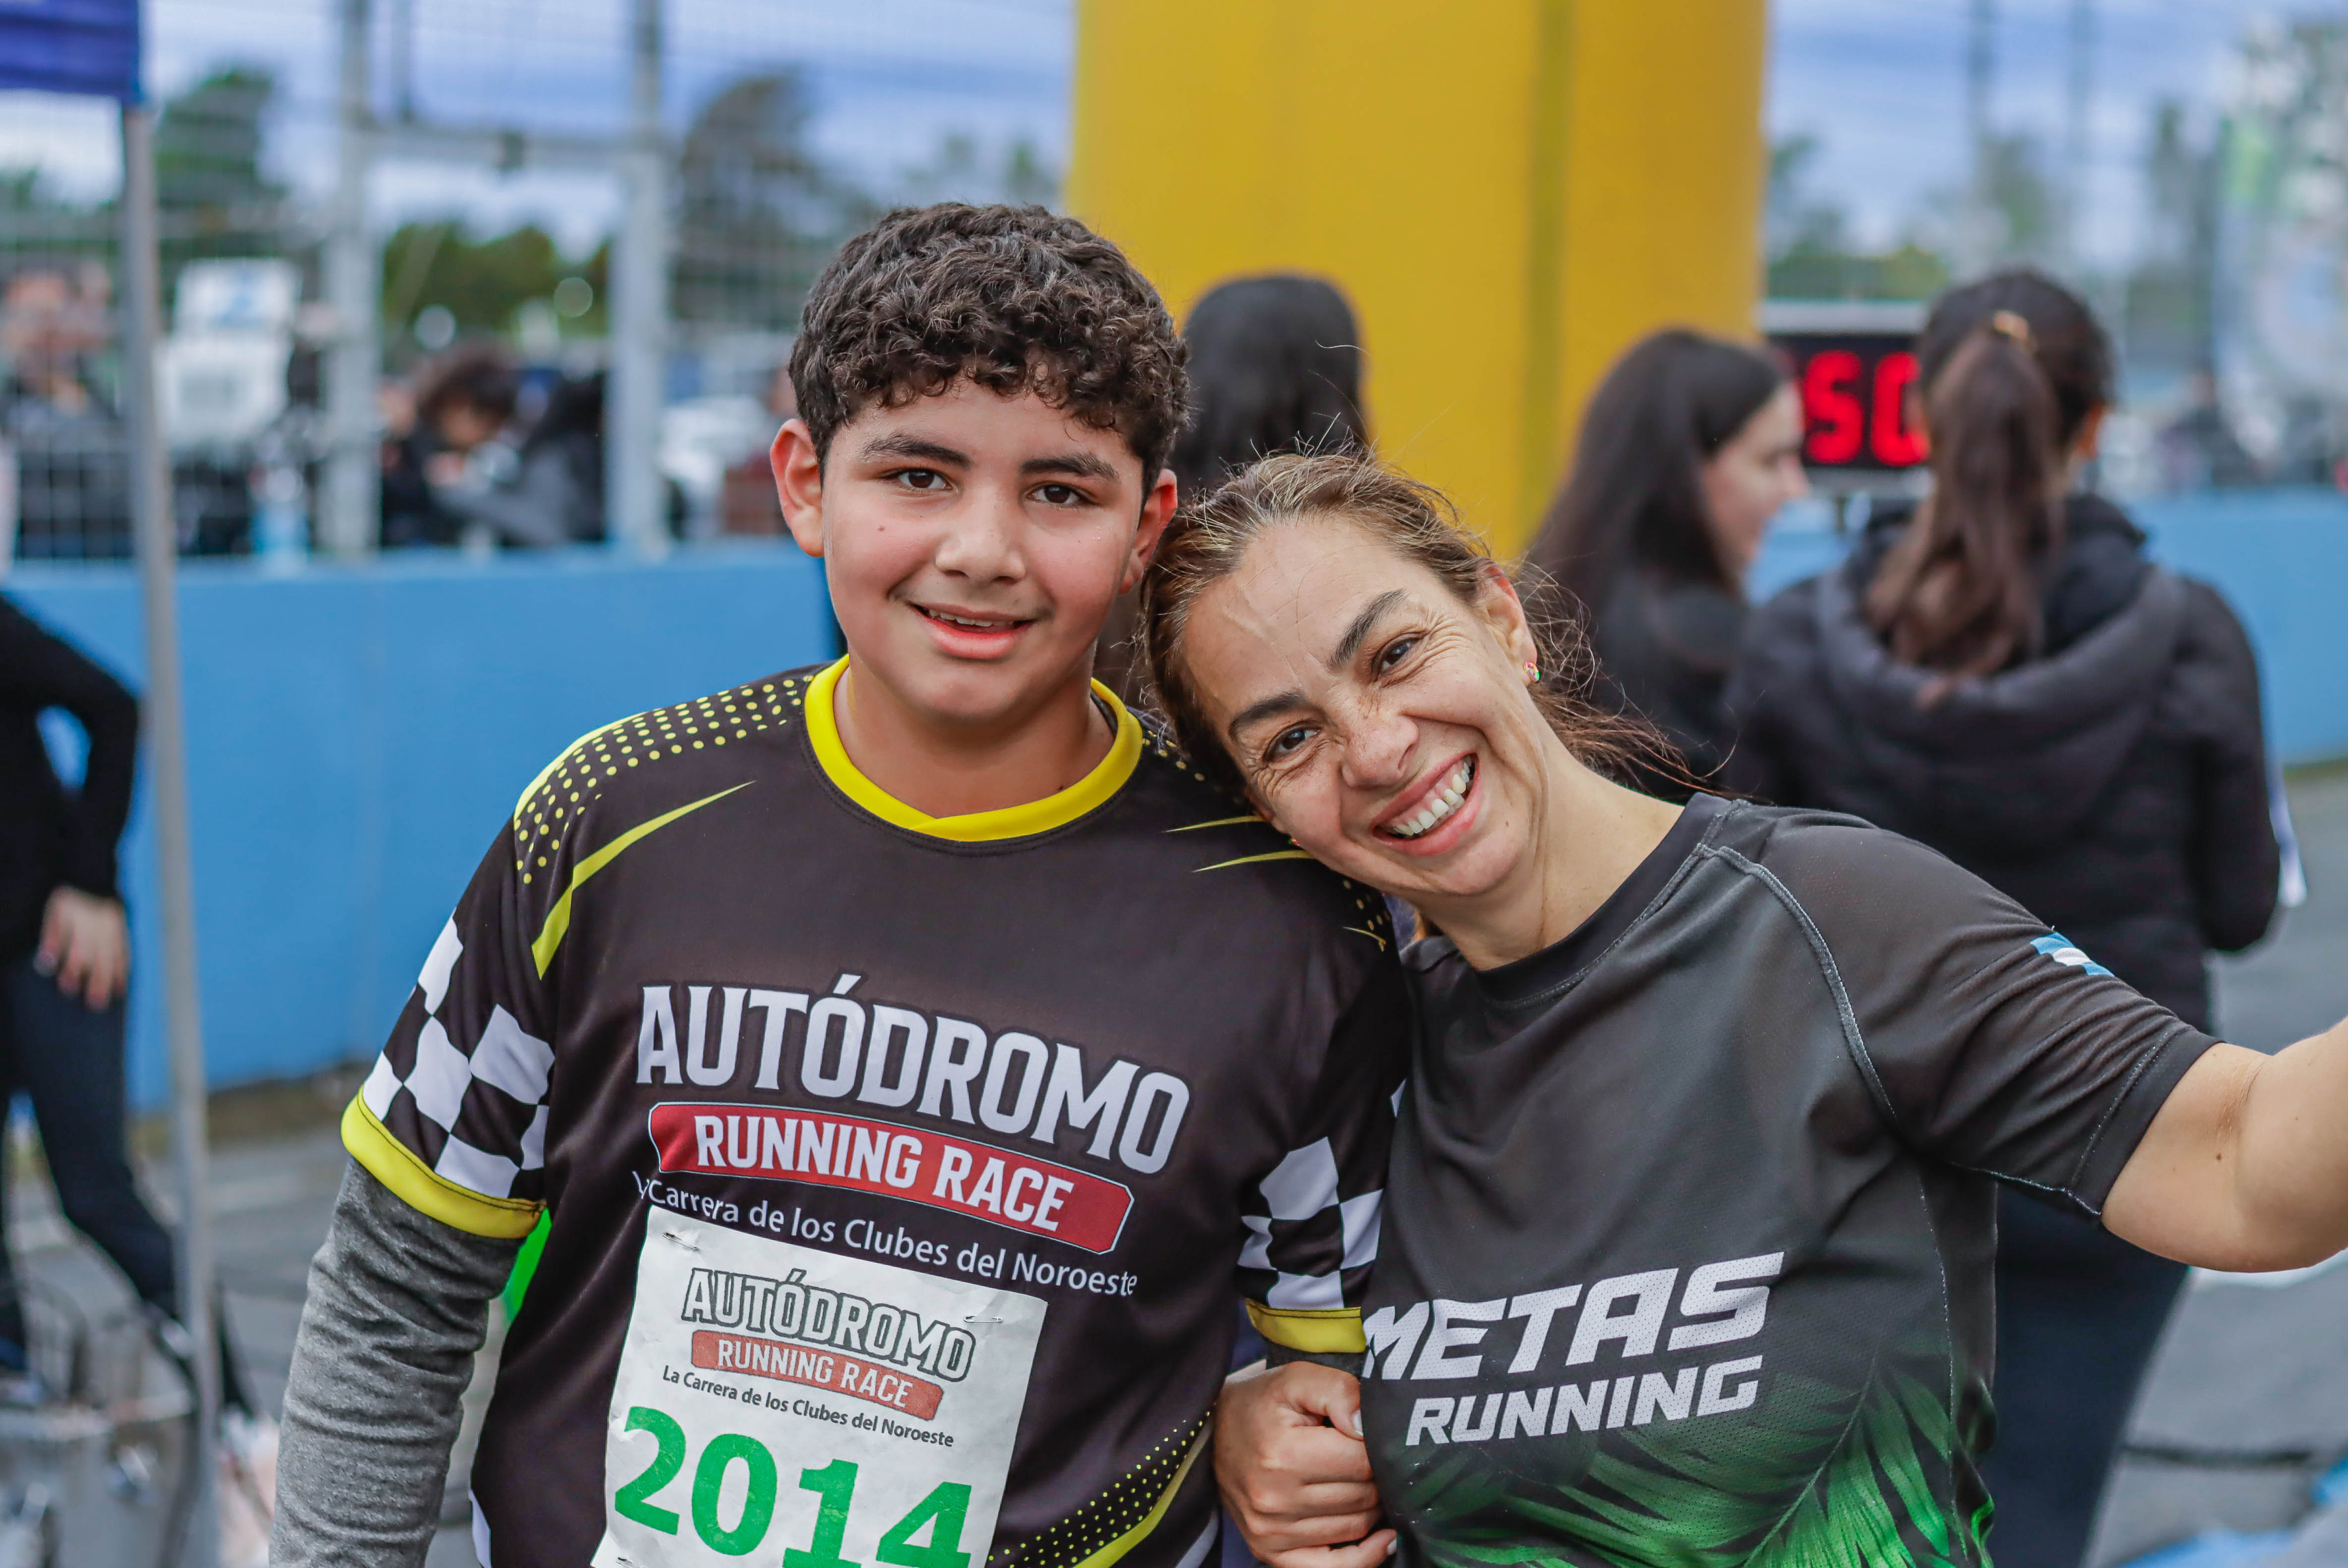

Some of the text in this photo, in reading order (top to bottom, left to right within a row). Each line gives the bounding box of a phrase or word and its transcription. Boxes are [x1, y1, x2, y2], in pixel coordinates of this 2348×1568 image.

[636, 973, 1190, 1174] AUTÓDROMO
[694, 1115, 1074, 1232] RUNNING RACE
[648, 1179, 739, 1223] Carrera
[749, 1200, 785, 1232] de
[791, 1207, 836, 1242] los
[844, 1219, 949, 1266] Clubes
[956, 1242, 1006, 1279] del
[1012, 1252, 1138, 1296] Noroeste
[681, 1268, 976, 1383] AUTÓDROMO
[718, 1339, 913, 1408] RUNNING RACE
[1362, 1251, 1784, 1380] METAS
[663, 1365, 954, 1448] La Carrera de los Clubes del Noroeste
[1405, 1354, 1763, 1446] RUNNING
[615, 1406, 972, 1568] 2014
